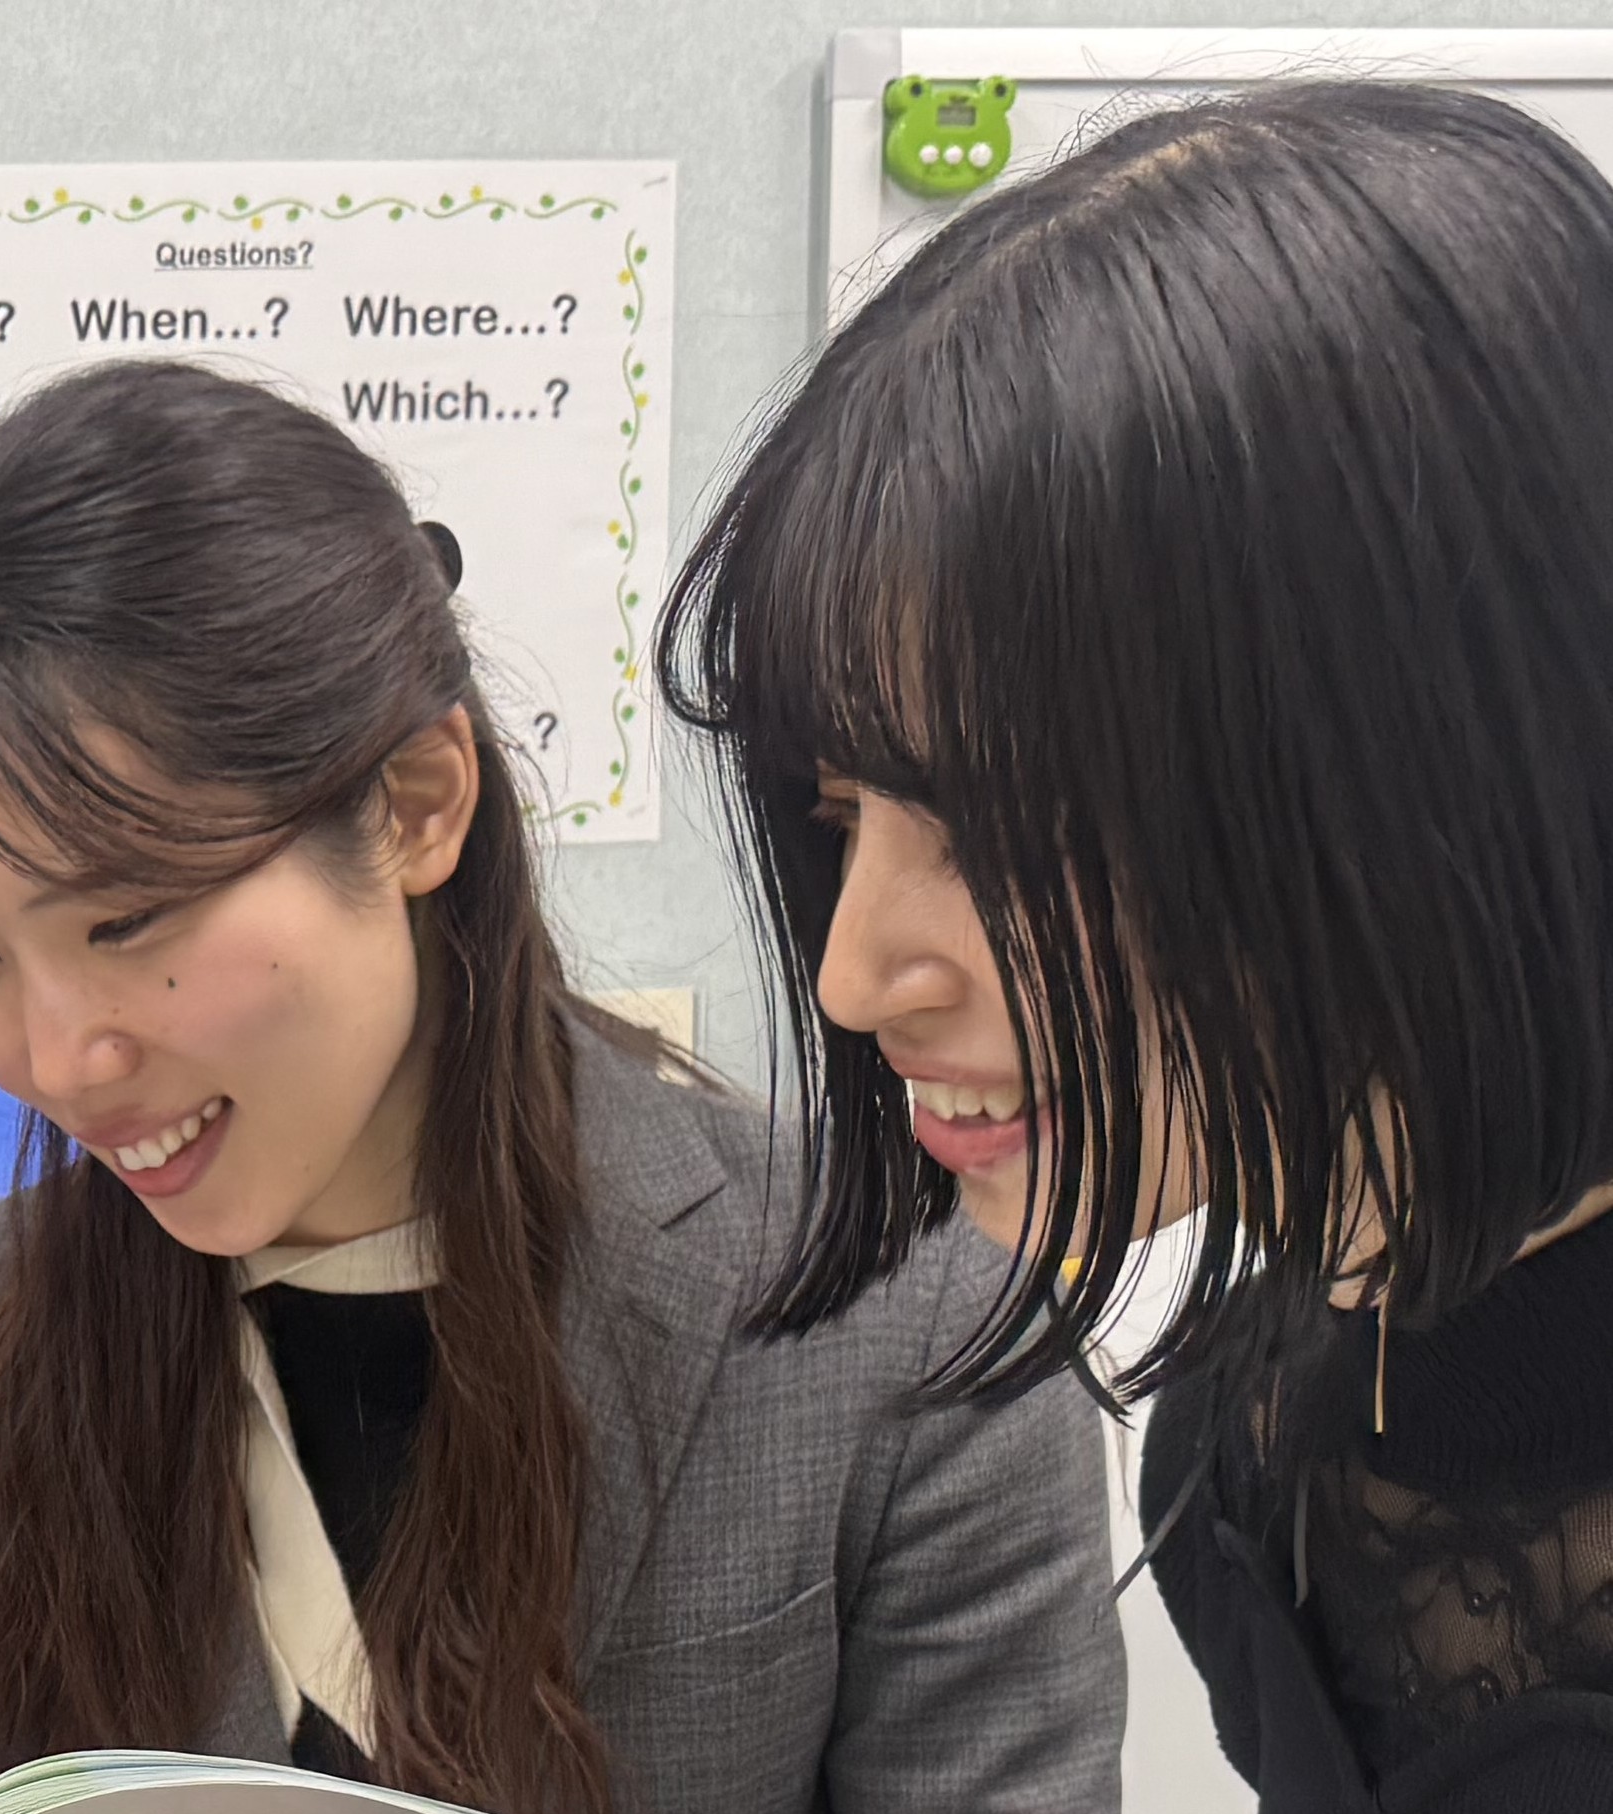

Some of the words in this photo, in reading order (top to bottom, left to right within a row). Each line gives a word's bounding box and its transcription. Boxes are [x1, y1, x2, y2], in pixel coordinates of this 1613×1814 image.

[155, 240, 314, 268] Questions?
[71, 297, 290, 342] When...?
[343, 293, 578, 338] Where...?
[342, 377, 571, 422] Which...?
[534, 711, 558, 751] ?
